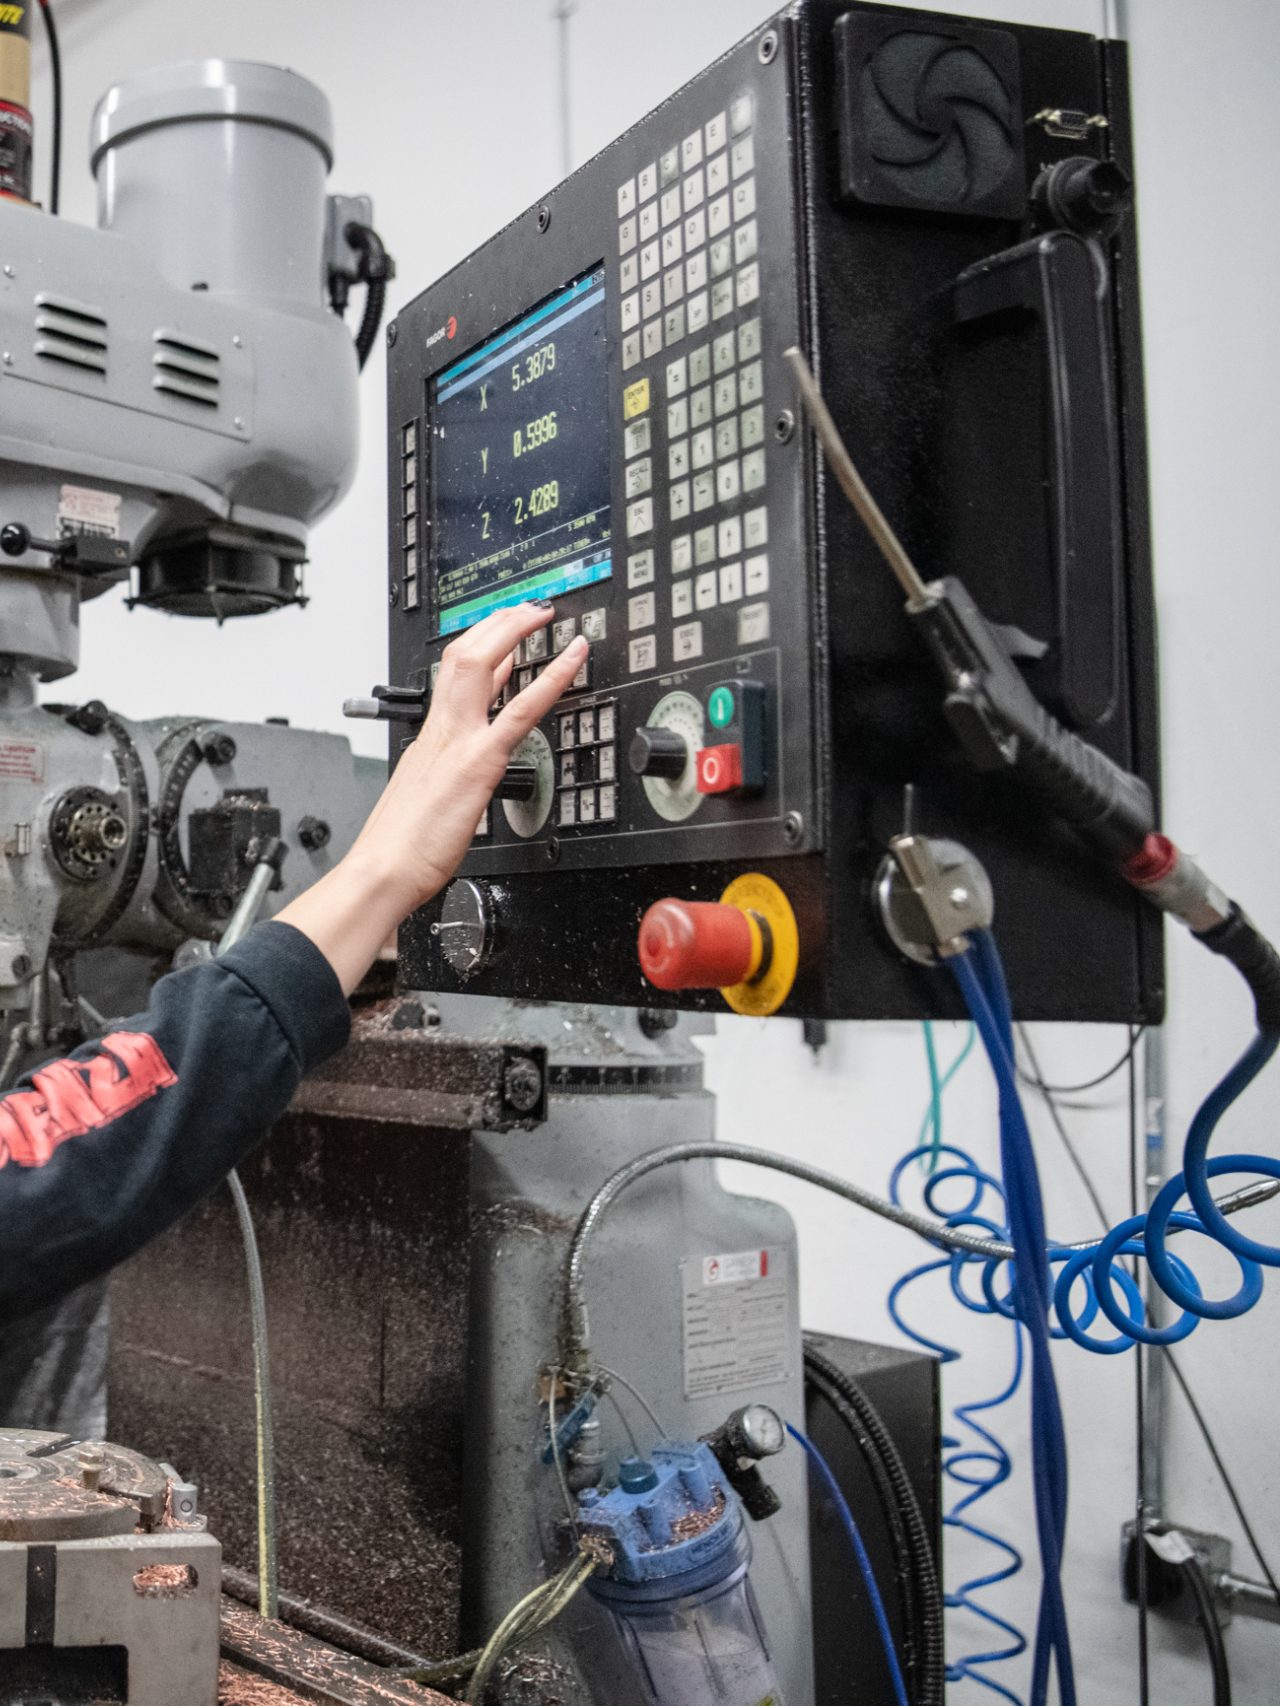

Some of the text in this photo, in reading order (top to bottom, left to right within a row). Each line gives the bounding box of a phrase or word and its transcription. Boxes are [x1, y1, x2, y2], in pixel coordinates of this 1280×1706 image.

[480, 343, 555, 411] X 5.3879
[481, 411, 557, 474] Y 0.5996
[482, 480, 558, 539] Z 2.4289
